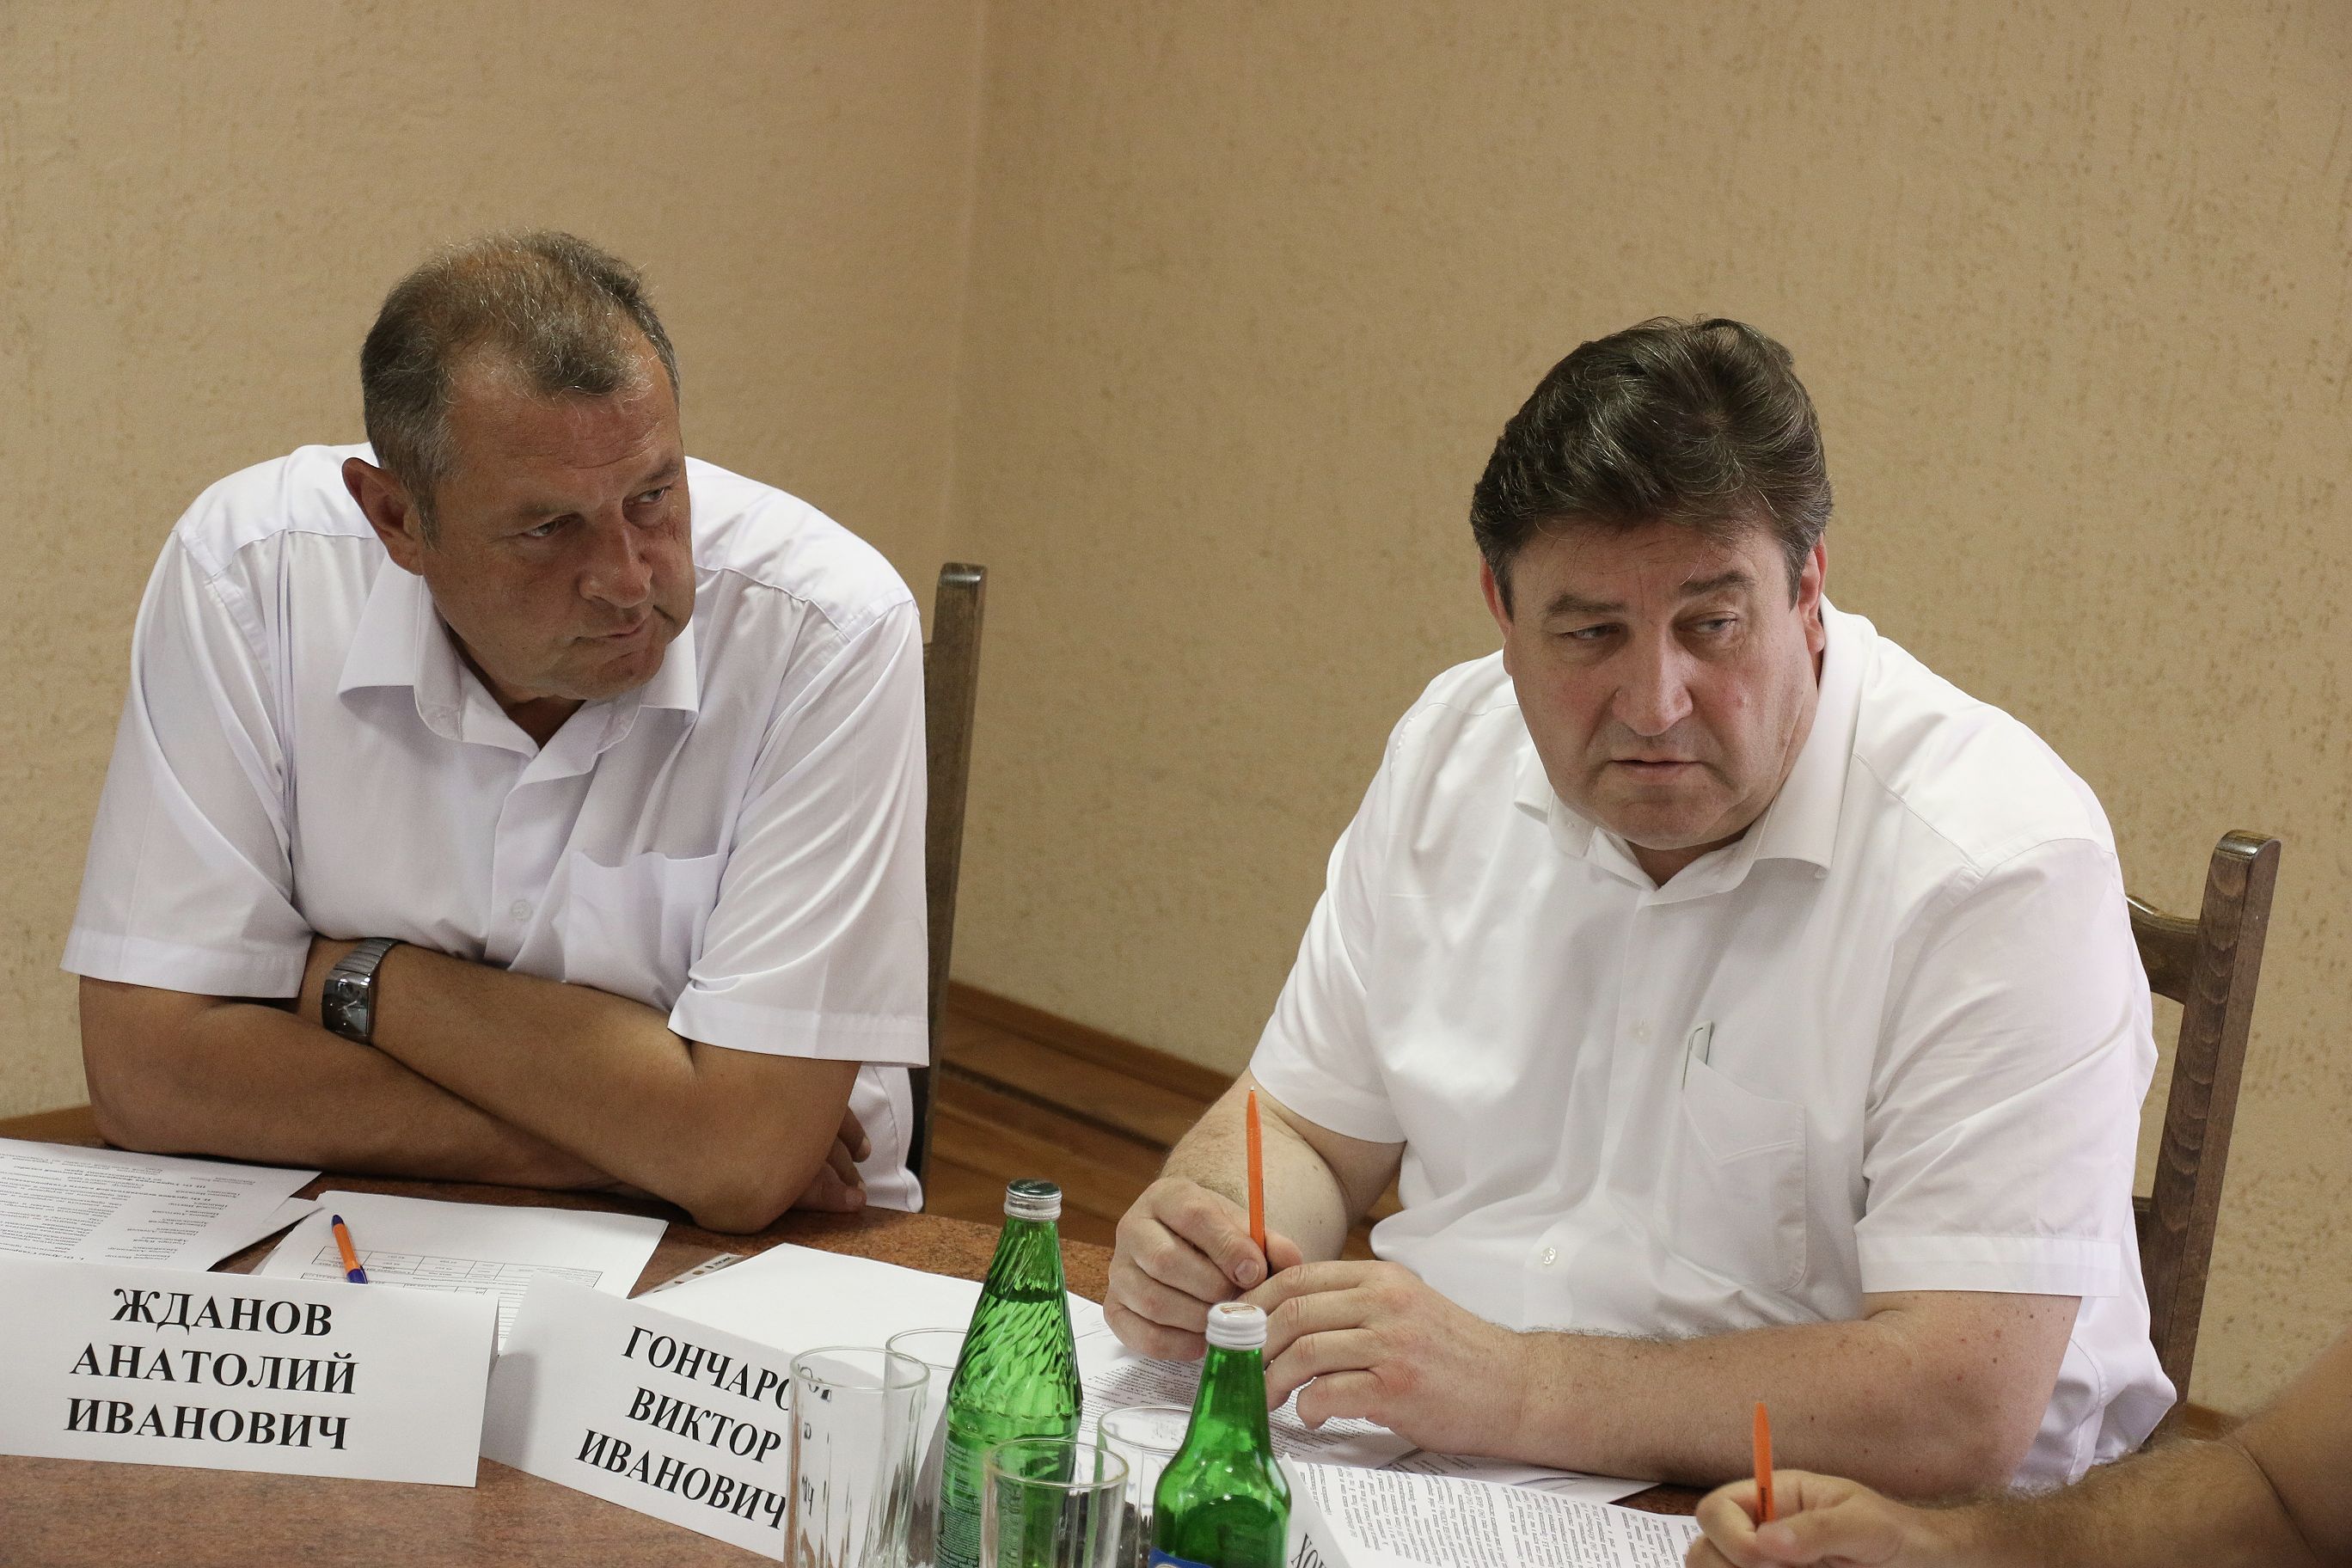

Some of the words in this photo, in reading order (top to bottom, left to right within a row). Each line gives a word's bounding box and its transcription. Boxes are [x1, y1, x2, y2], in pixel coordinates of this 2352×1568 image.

[111, 1288, 332, 1336] ЖДАНОВ
[70, 1343, 359, 1394] АНАТОЛИЙ
[621, 1326, 832, 1412] ГОНЧАРО
[64, 1398, 351, 1450] ИВАНОВИЧ
[626, 1387, 781, 1463] ВИКТОР
[574, 1429, 786, 1530] ИВАНОВИЧ
